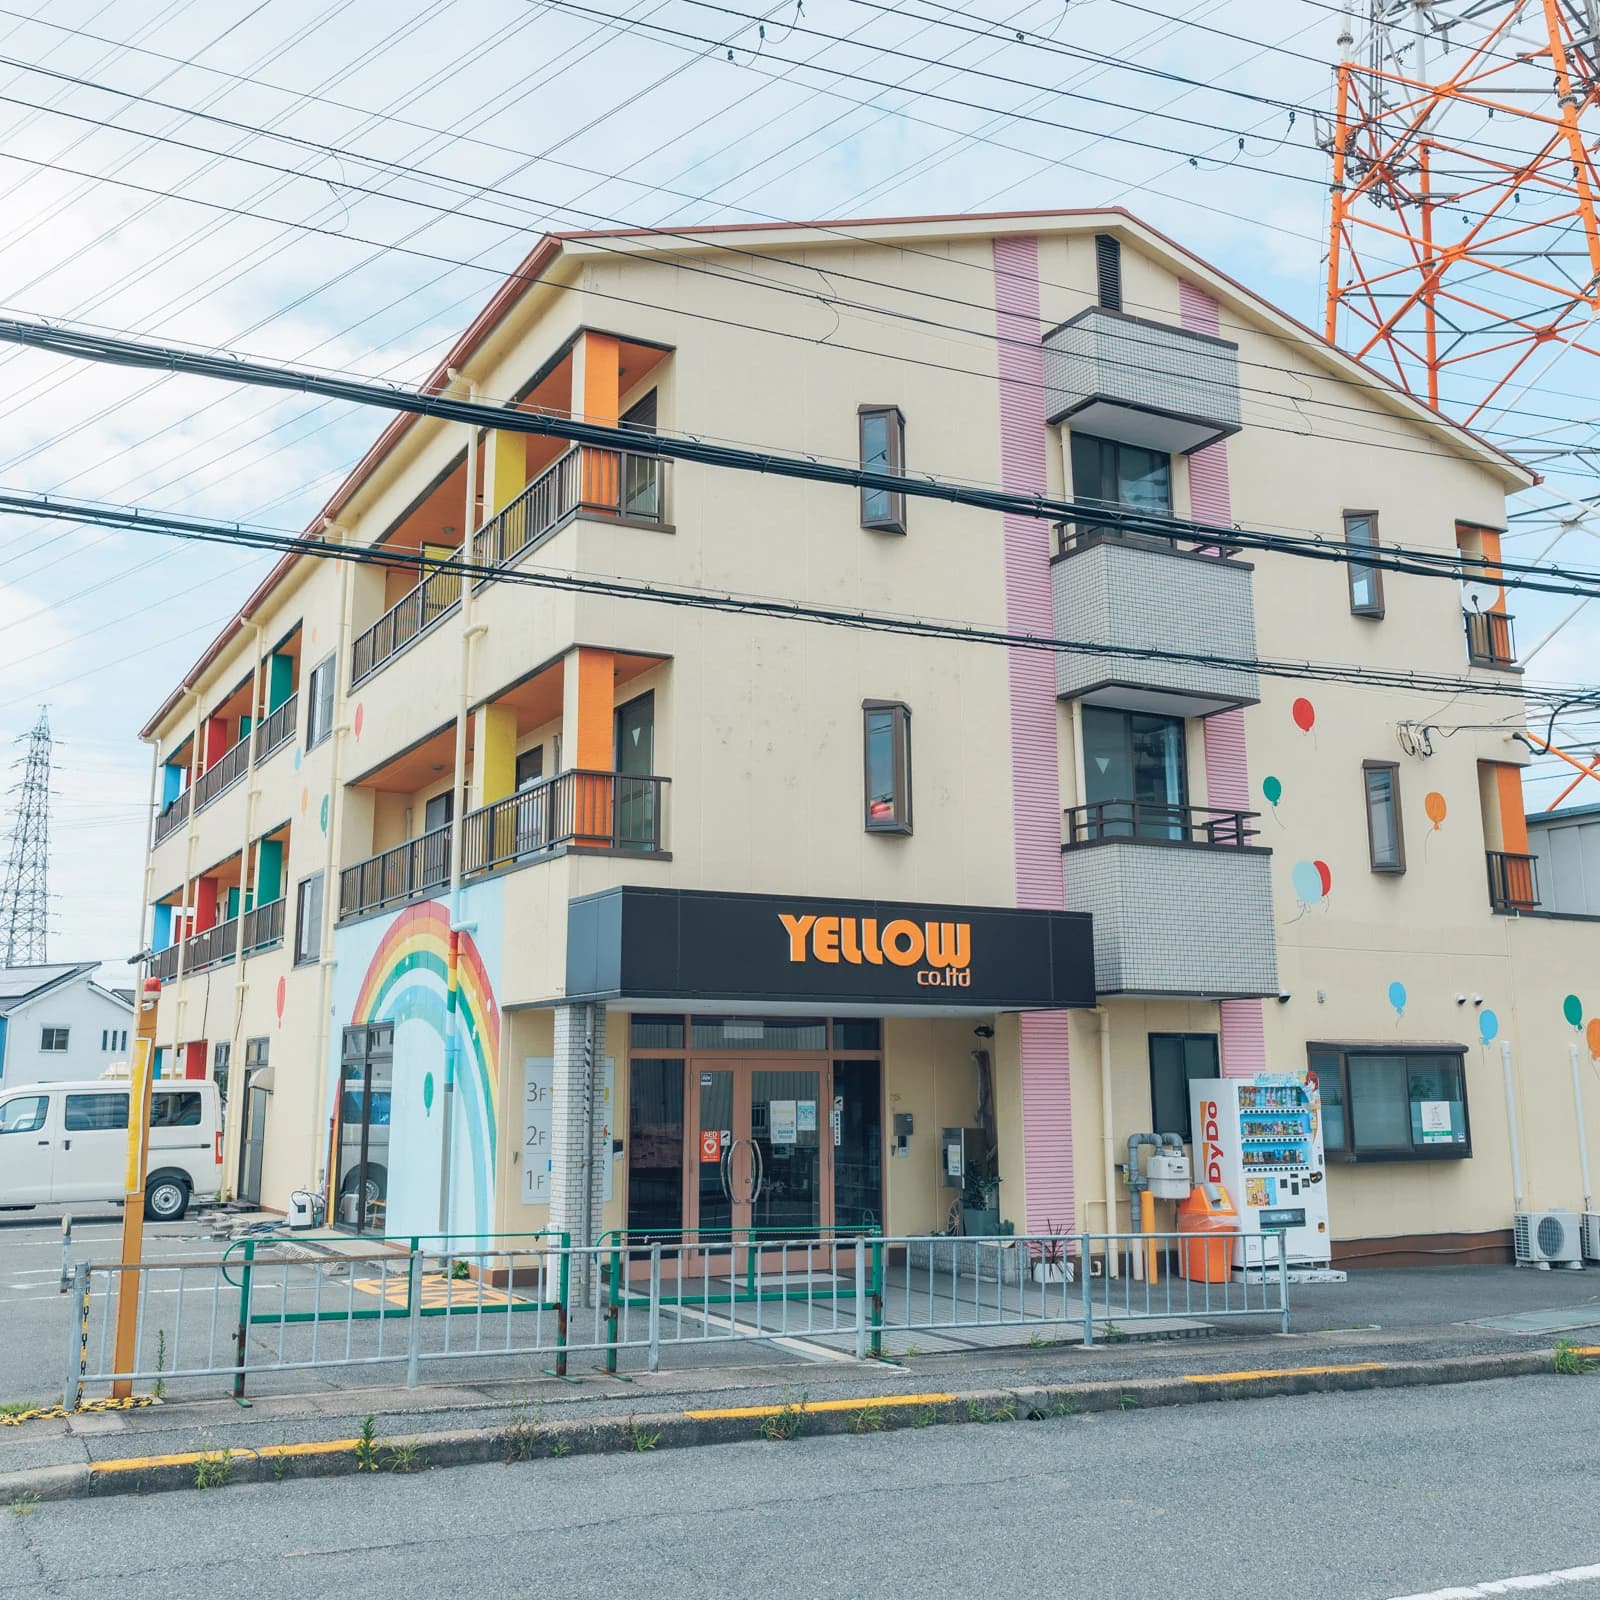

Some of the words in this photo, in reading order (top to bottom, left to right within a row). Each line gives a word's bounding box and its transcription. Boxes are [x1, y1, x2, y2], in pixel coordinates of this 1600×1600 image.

[778, 914, 971, 969] YELLOW
[917, 968, 971, 987] co.ltd
[527, 1082, 547, 1102] 3F
[526, 1126, 546, 1146] 2F
[526, 1170, 545, 1190] 1F
